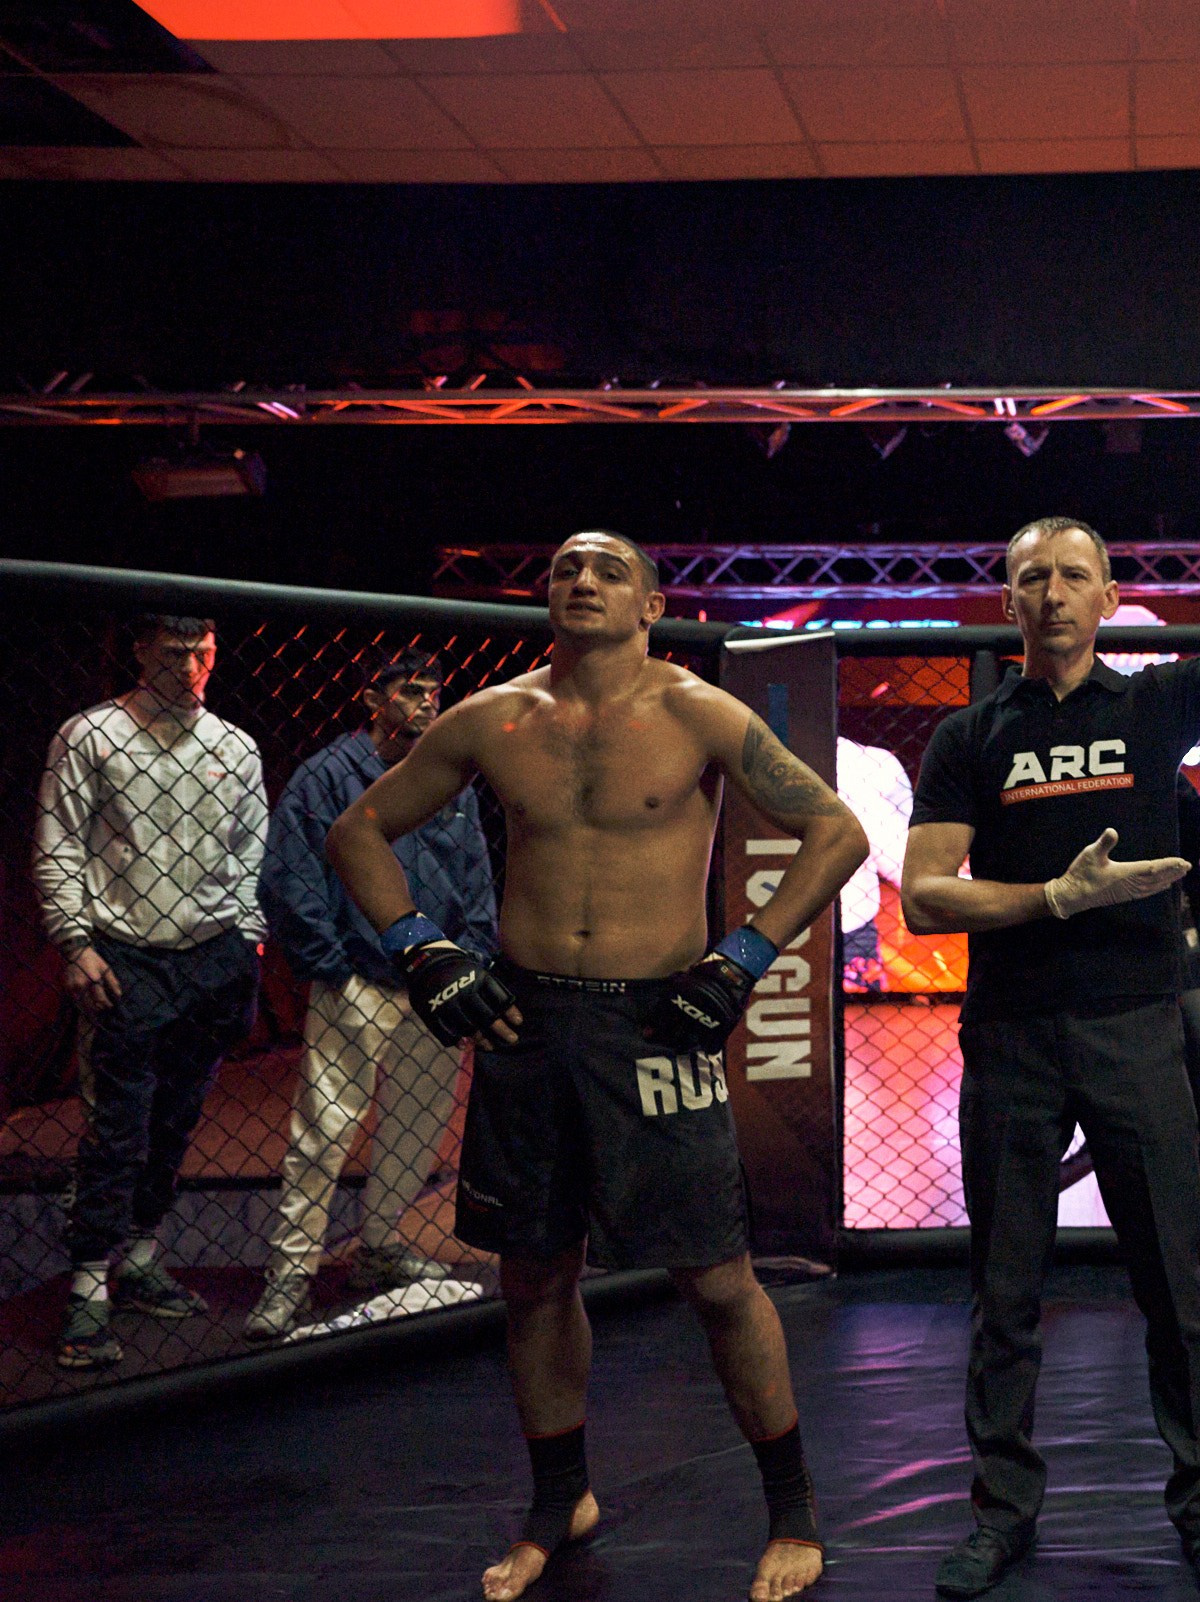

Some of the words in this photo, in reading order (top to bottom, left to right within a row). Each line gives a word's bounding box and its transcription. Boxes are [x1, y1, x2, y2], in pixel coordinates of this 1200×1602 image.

[1002, 738, 1127, 790] ARC
[1004, 782, 1076, 802] INTERNATIONAL
[1077, 776, 1132, 790] FEDERATION
[428, 969, 475, 1013] RDX
[670, 993, 720, 1029] RDX
